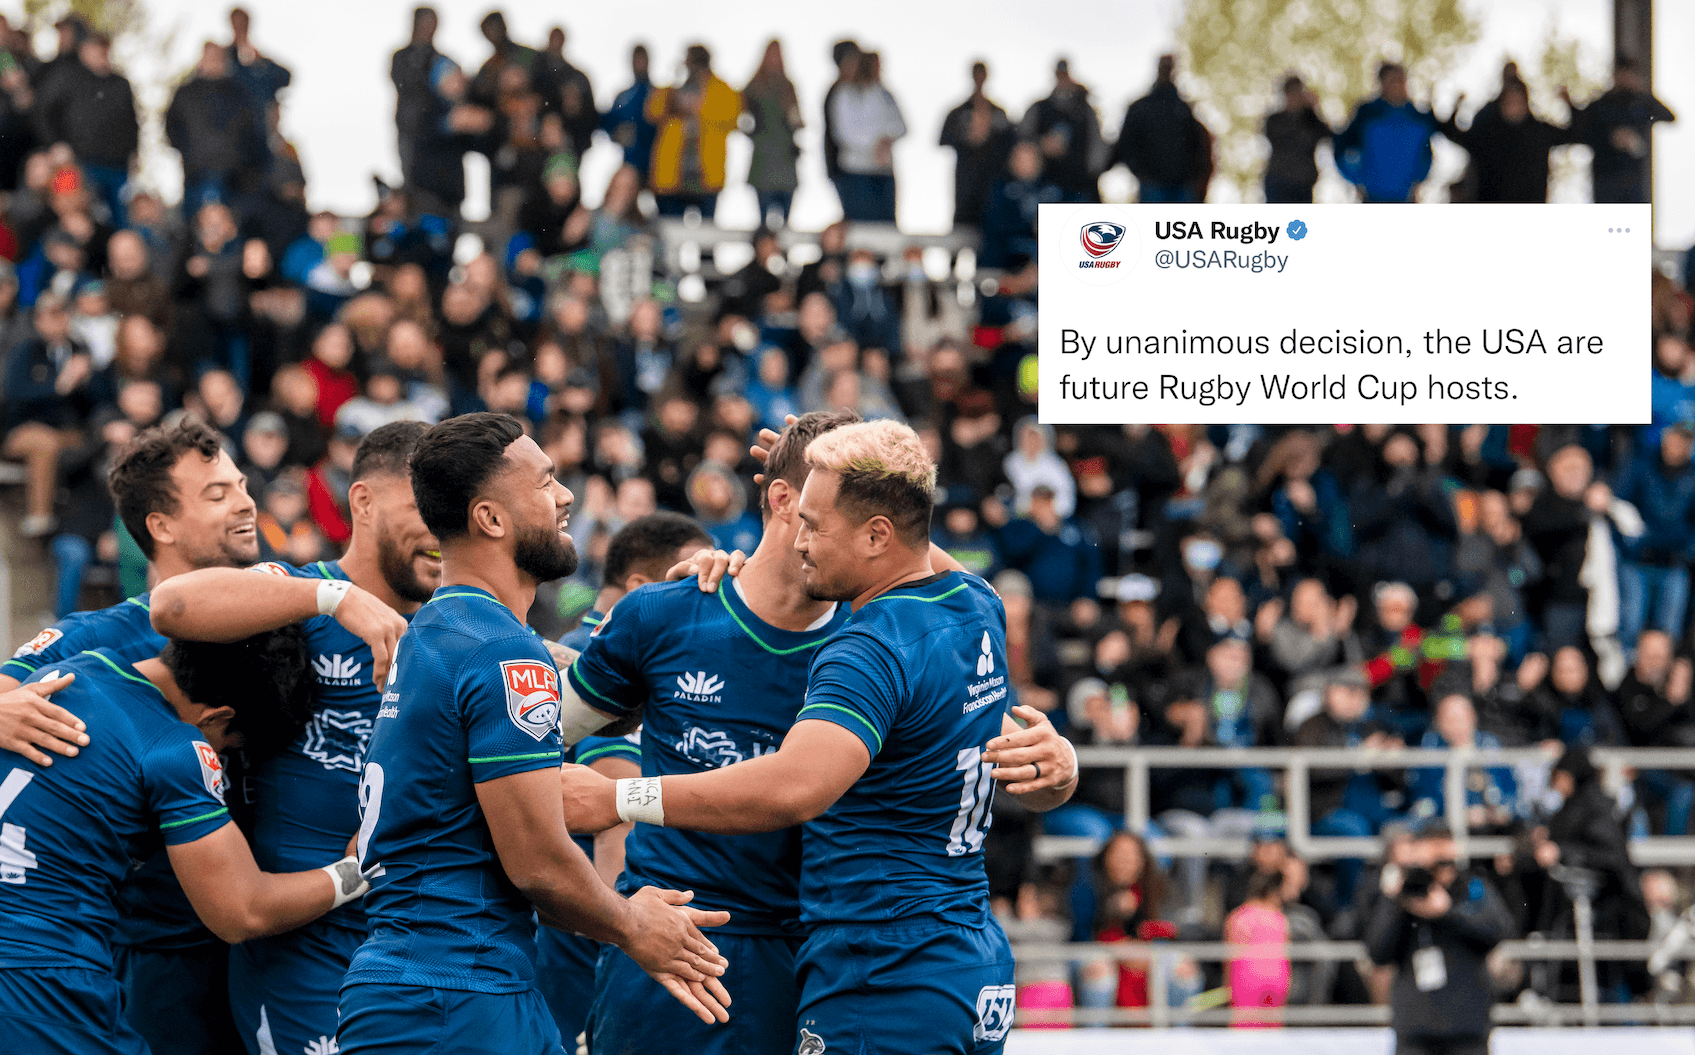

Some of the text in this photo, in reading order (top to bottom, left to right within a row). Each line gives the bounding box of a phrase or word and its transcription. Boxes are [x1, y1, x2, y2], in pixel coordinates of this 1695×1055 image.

[315, 676, 361, 686] ALADIN
[511, 669, 556, 690] MLR
[673, 691, 722, 703] PALADIN
